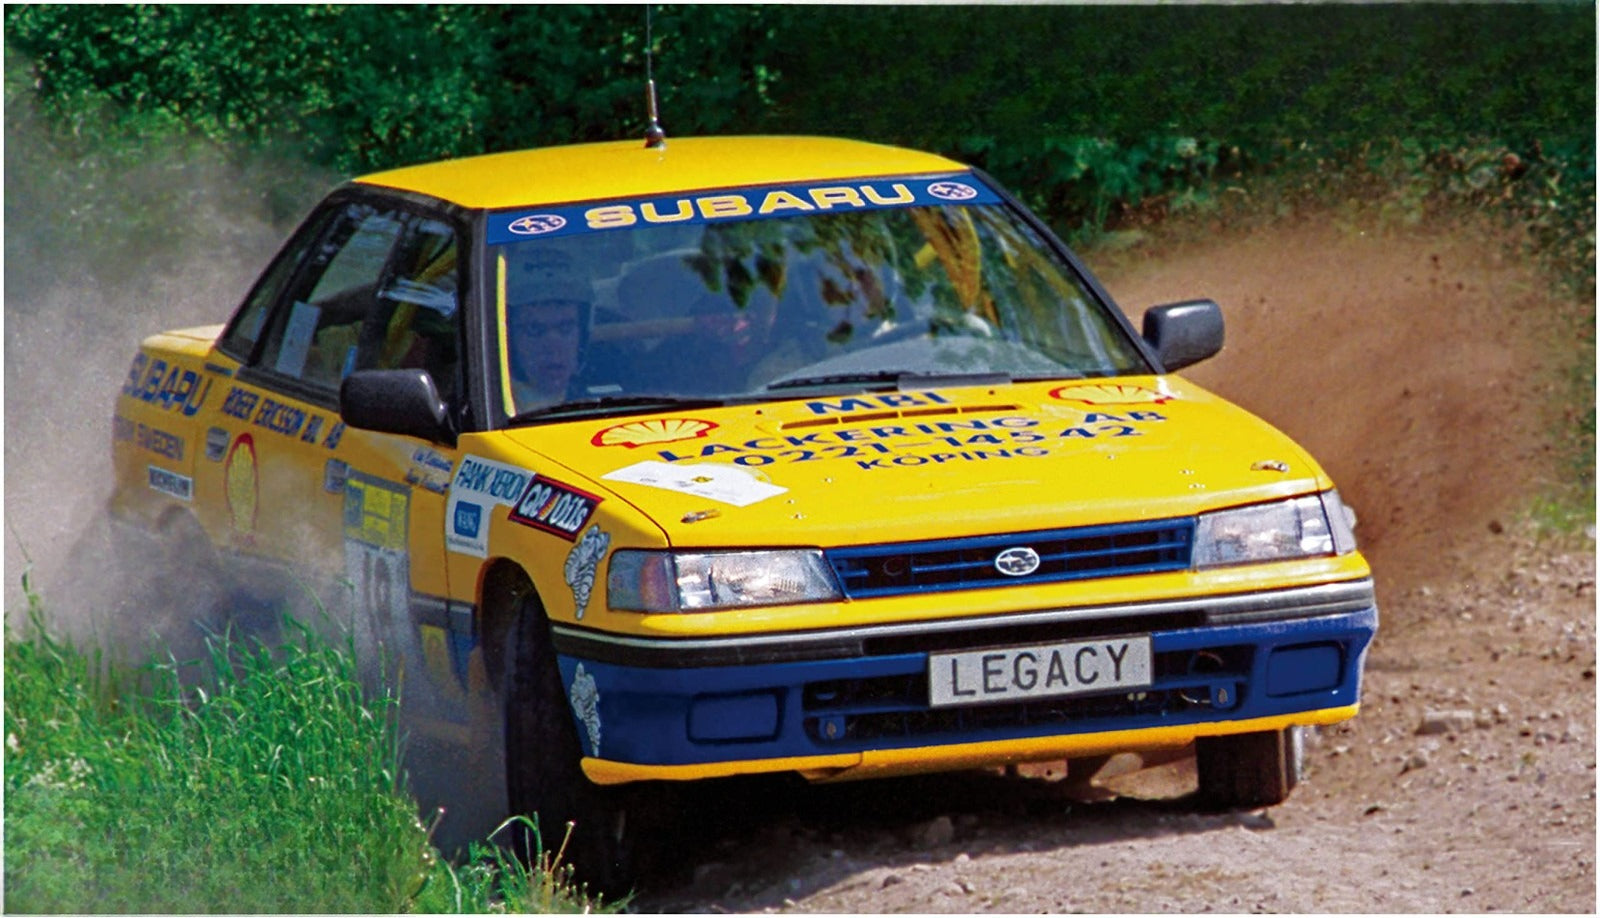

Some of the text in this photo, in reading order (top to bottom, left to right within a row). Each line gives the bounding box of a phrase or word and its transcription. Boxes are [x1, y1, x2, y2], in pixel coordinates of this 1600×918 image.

[584, 183, 915, 229] SUBARU
[122, 352, 213, 416] SUBARU
[805, 391, 952, 415] MBI
[657, 410, 1168, 463] LACKERING AB
[518, 483, 552, 518] Q8
[951, 643, 1129, 697] LEGACY
